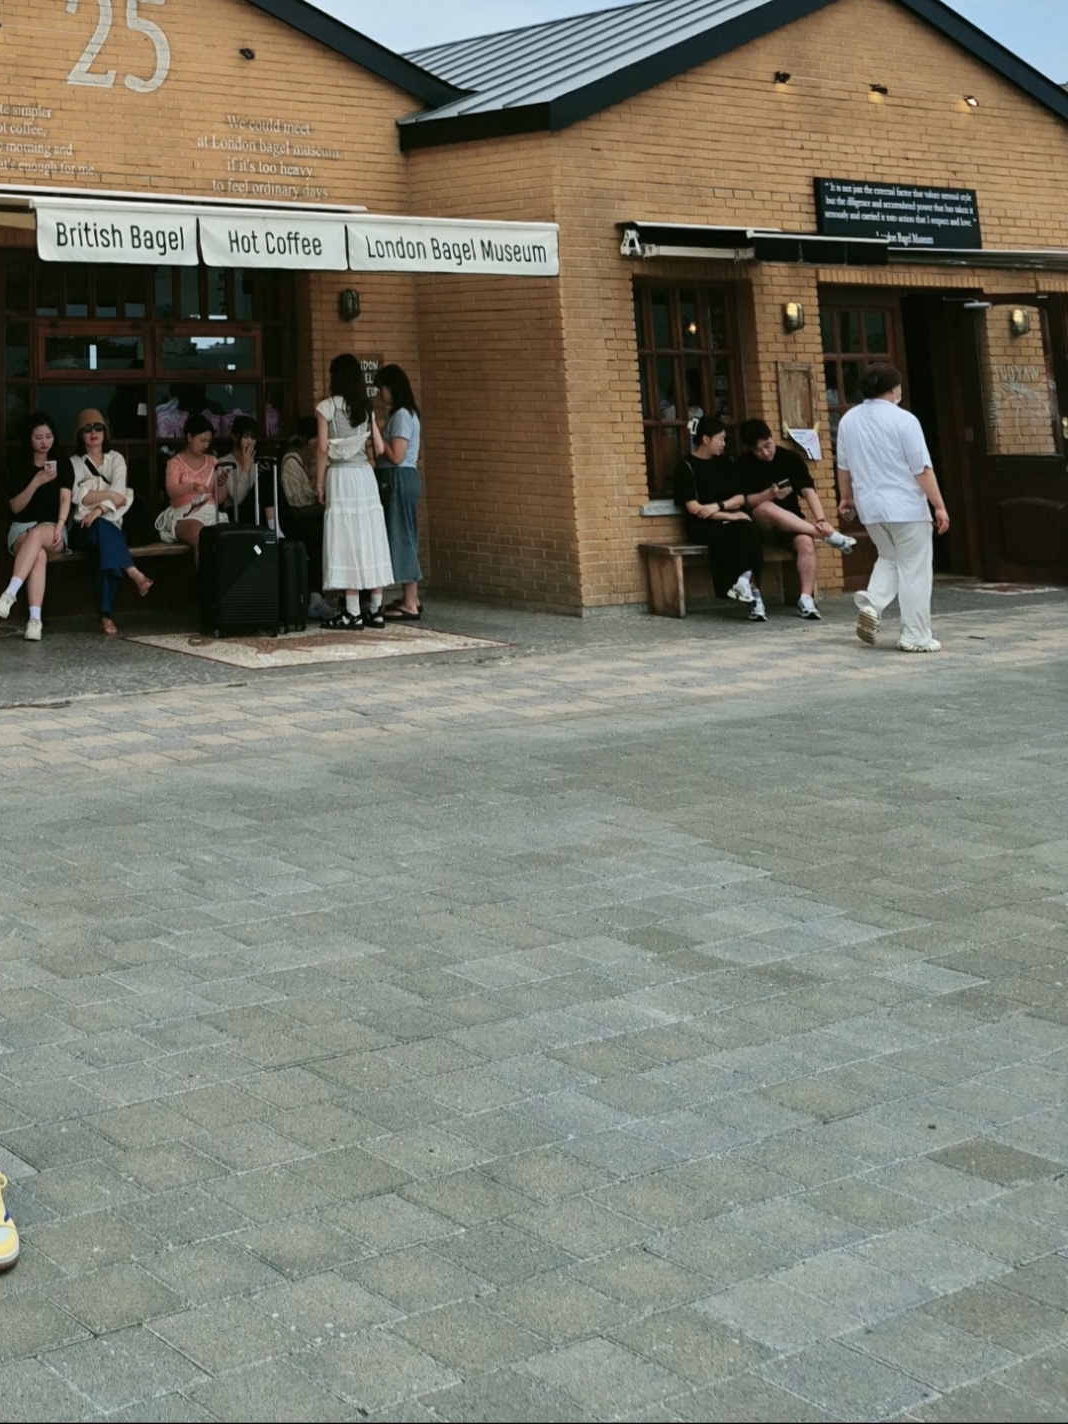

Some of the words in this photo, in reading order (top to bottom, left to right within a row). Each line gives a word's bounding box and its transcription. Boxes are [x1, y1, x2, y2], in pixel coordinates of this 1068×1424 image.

[12, 103, 52, 119] simpler
[227, 115, 245, 130] We
[250, 118, 280, 133] could
[283, 122, 311, 135] meet
[6, 142, 51, 157] morning
[53, 143, 73, 156] and
[197, 136, 208, 148] at
[212, 135, 256, 151] London
[259, 138, 290, 157] bagel
[293, 144, 340, 158] museum
[18, 160, 57, 175] enough
[60, 161, 76, 175] for
[227, 156, 237, 171] if
[239, 158, 255, 173] it's
[259, 161, 277, 174] too
[280, 160, 313, 179] heavy
[213, 180, 224, 191] to
[227, 178, 248, 193] feel
[252, 180, 299, 200] ordinary
[302, 183, 328, 201] days
[55, 222, 123, 251] British
[130, 224, 185, 255] Bagel
[228, 229, 259, 255] Hot
[264, 231, 322, 257] Coffee
[365, 234, 426, 261] London
[430, 239, 475, 266] Bagel
[480, 240, 547, 264] Museum
